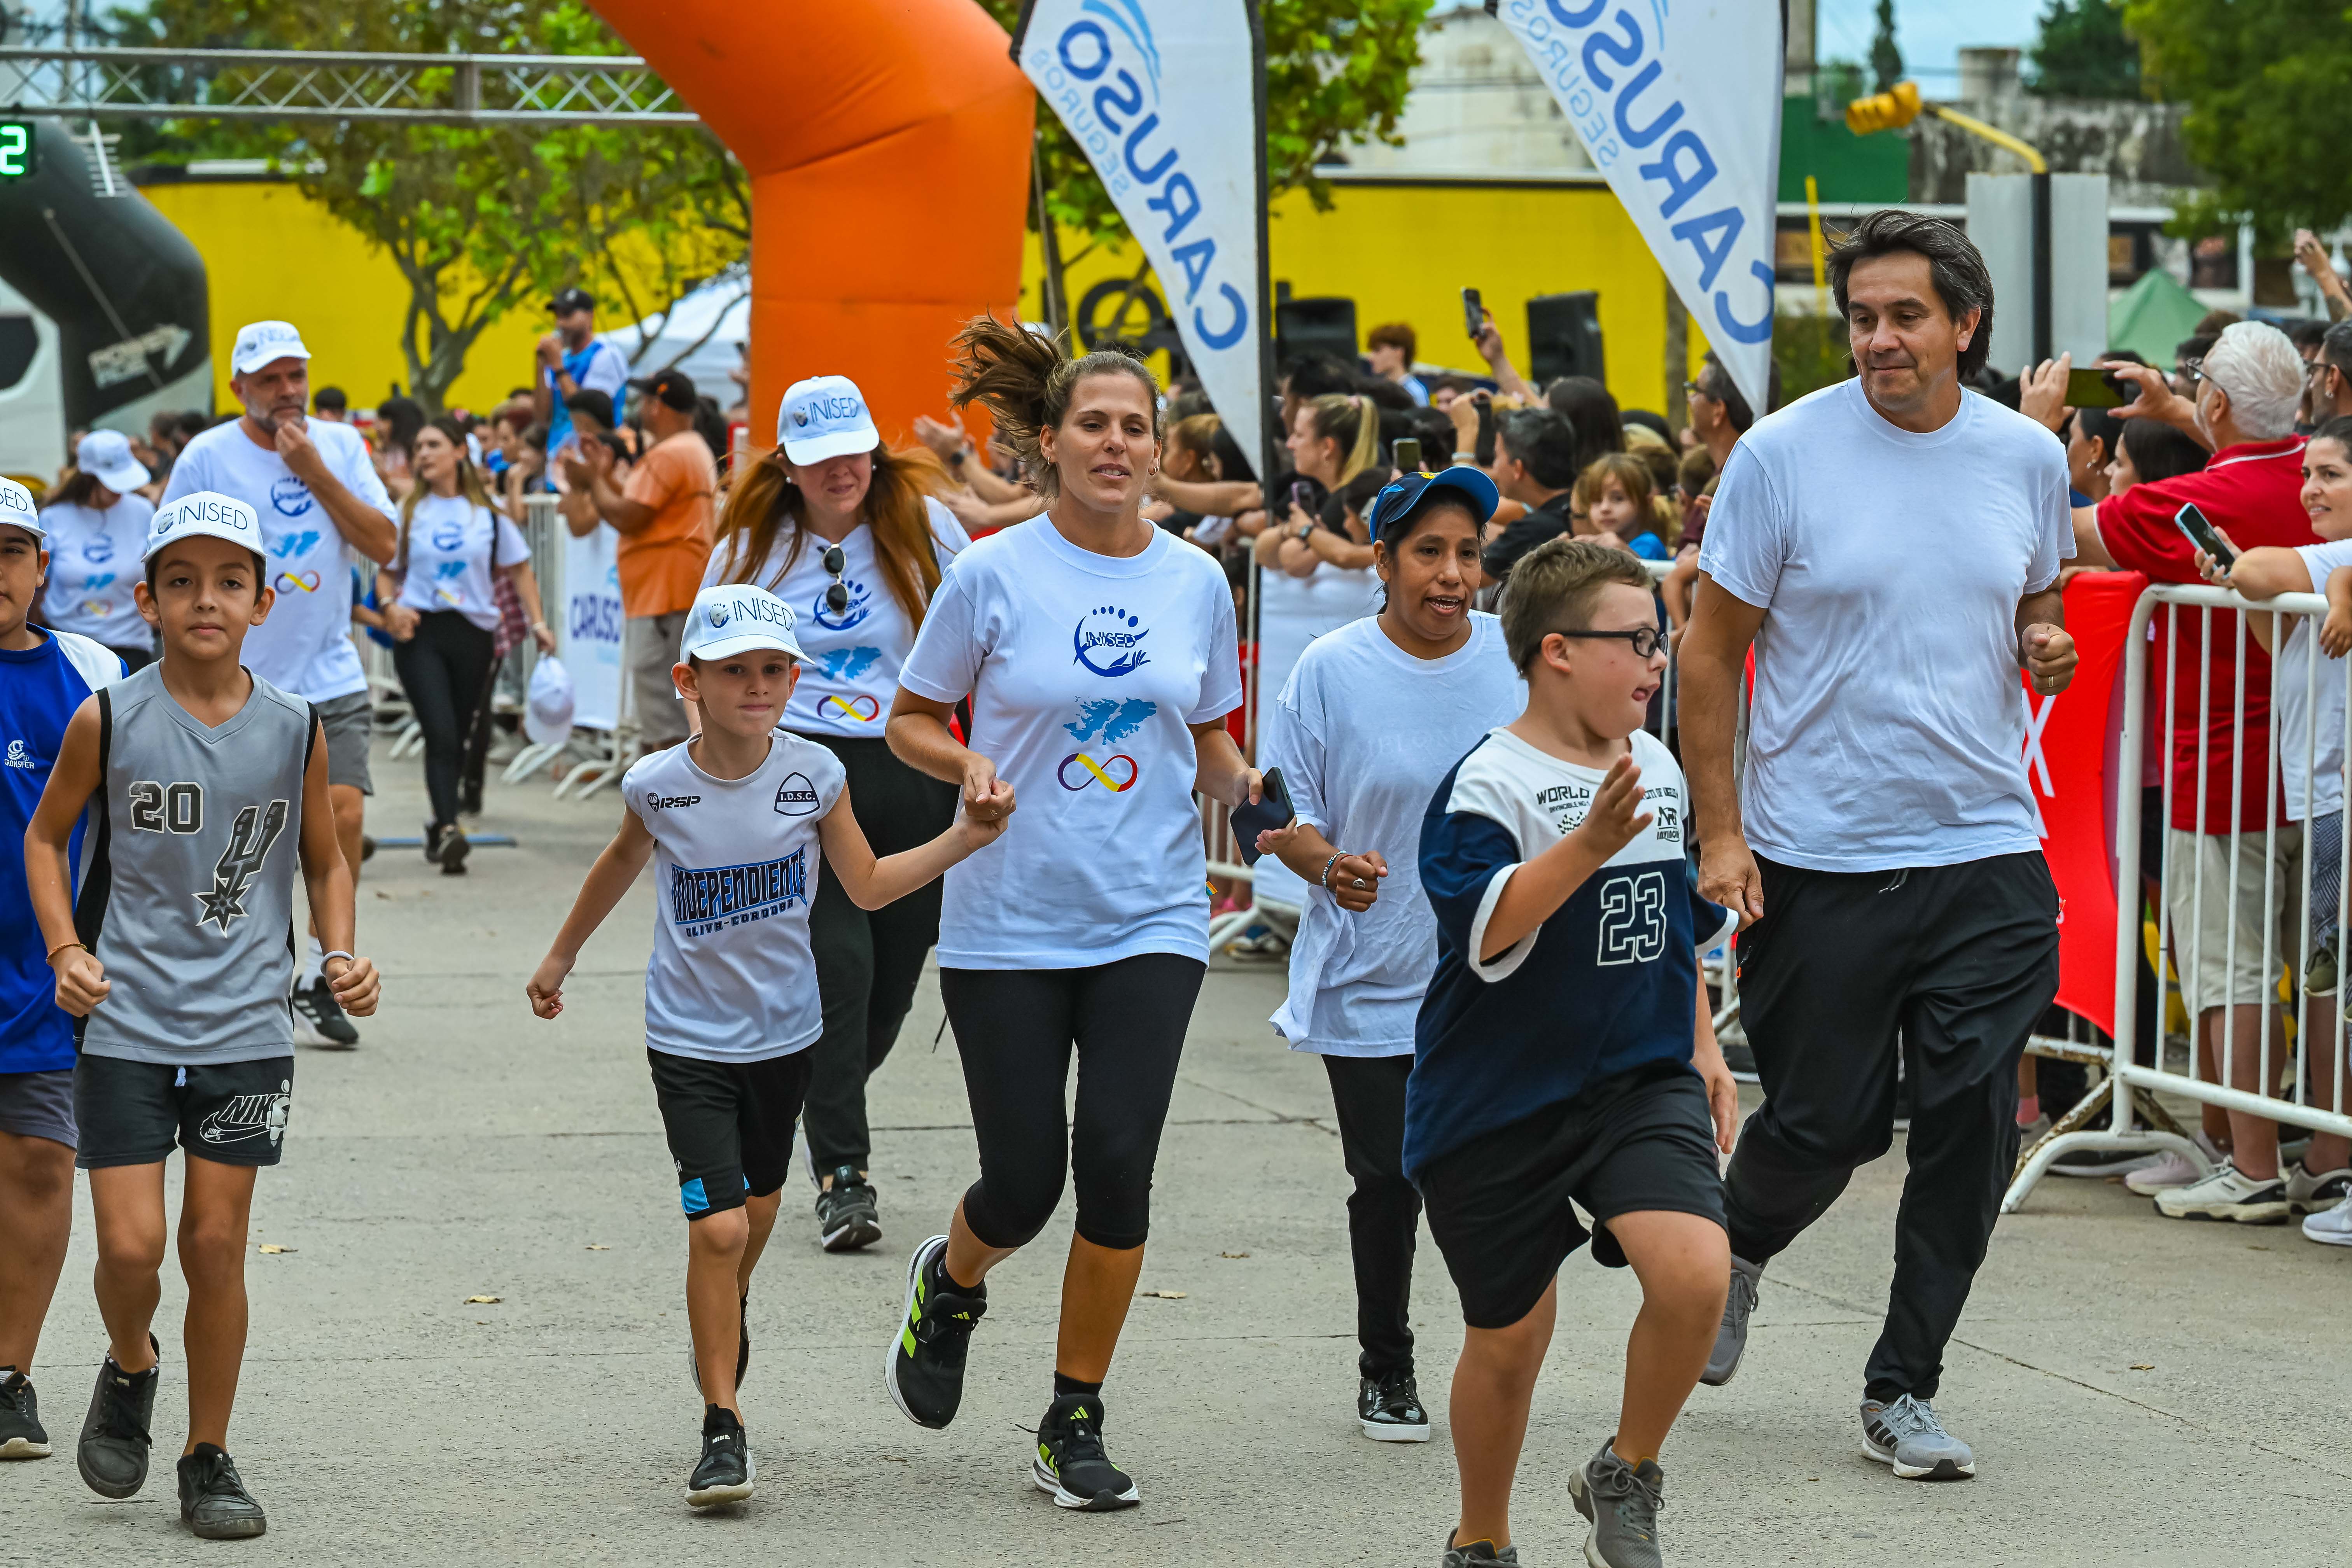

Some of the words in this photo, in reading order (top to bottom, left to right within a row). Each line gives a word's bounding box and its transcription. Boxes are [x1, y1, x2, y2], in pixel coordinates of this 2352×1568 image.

[0, 125, 26, 175] 2
[809, 398, 859, 424] INISED
[179, 502, 247, 530] INISED
[733, 598, 793, 631] INISED
[1085, 632, 1136, 648] INISED
[129, 780, 204, 835] 20
[660, 795, 701, 808] RSP
[780, 793, 815, 801] I.D.S.C.
[1537, 786, 1589, 805] WORLD
[672, 845, 807, 923] INDEPENDIENTE
[1597, 871, 1667, 966] 23
[712, 1434, 731, 1444] NIKE
